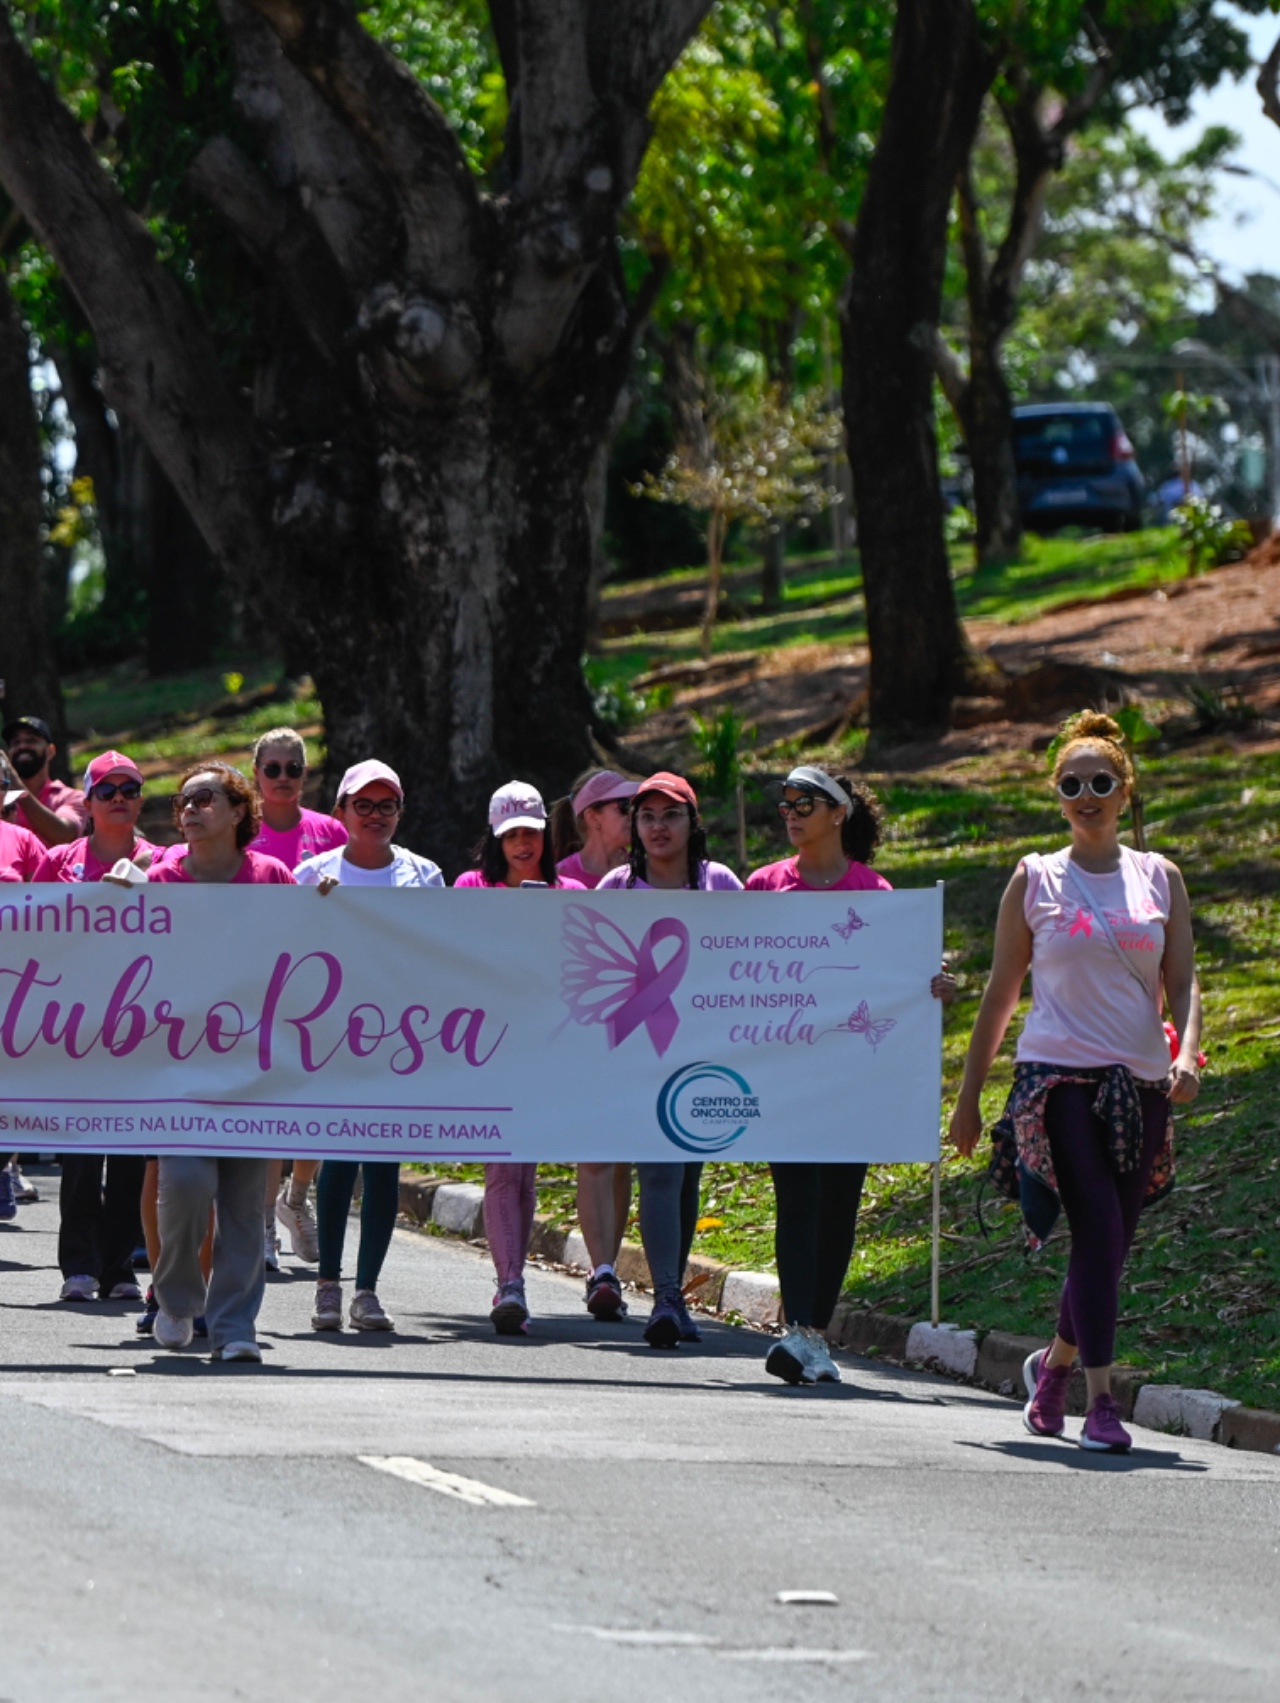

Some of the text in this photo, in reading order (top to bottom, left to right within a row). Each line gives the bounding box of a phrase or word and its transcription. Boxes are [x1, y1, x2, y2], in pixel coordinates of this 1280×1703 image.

[699, 935, 831, 951] QUEM PROCURA
[1119, 933, 1156, 952] uida
[728, 959, 860, 985] cura
[691, 993, 818, 1011] QUEM INSPIRA
[728, 1008, 838, 1046] cuida
[692, 1096, 760, 1107] CENTRO DE
[690, 1108, 762, 1118] ONCOLOGIA
[13, 1114, 61, 1132] MAIS
[65, 1115, 135, 1132] FORTES
[139, 1116, 167, 1132] NA
[170, 1115, 218, 1132] LUTA
[221, 1118, 302, 1136] CONTRA
[305, 1121, 321, 1137] O
[325, 1118, 403, 1139] CÂNCER
[409, 1123, 434, 1139] DE
[438, 1123, 502, 1140] MAMA
